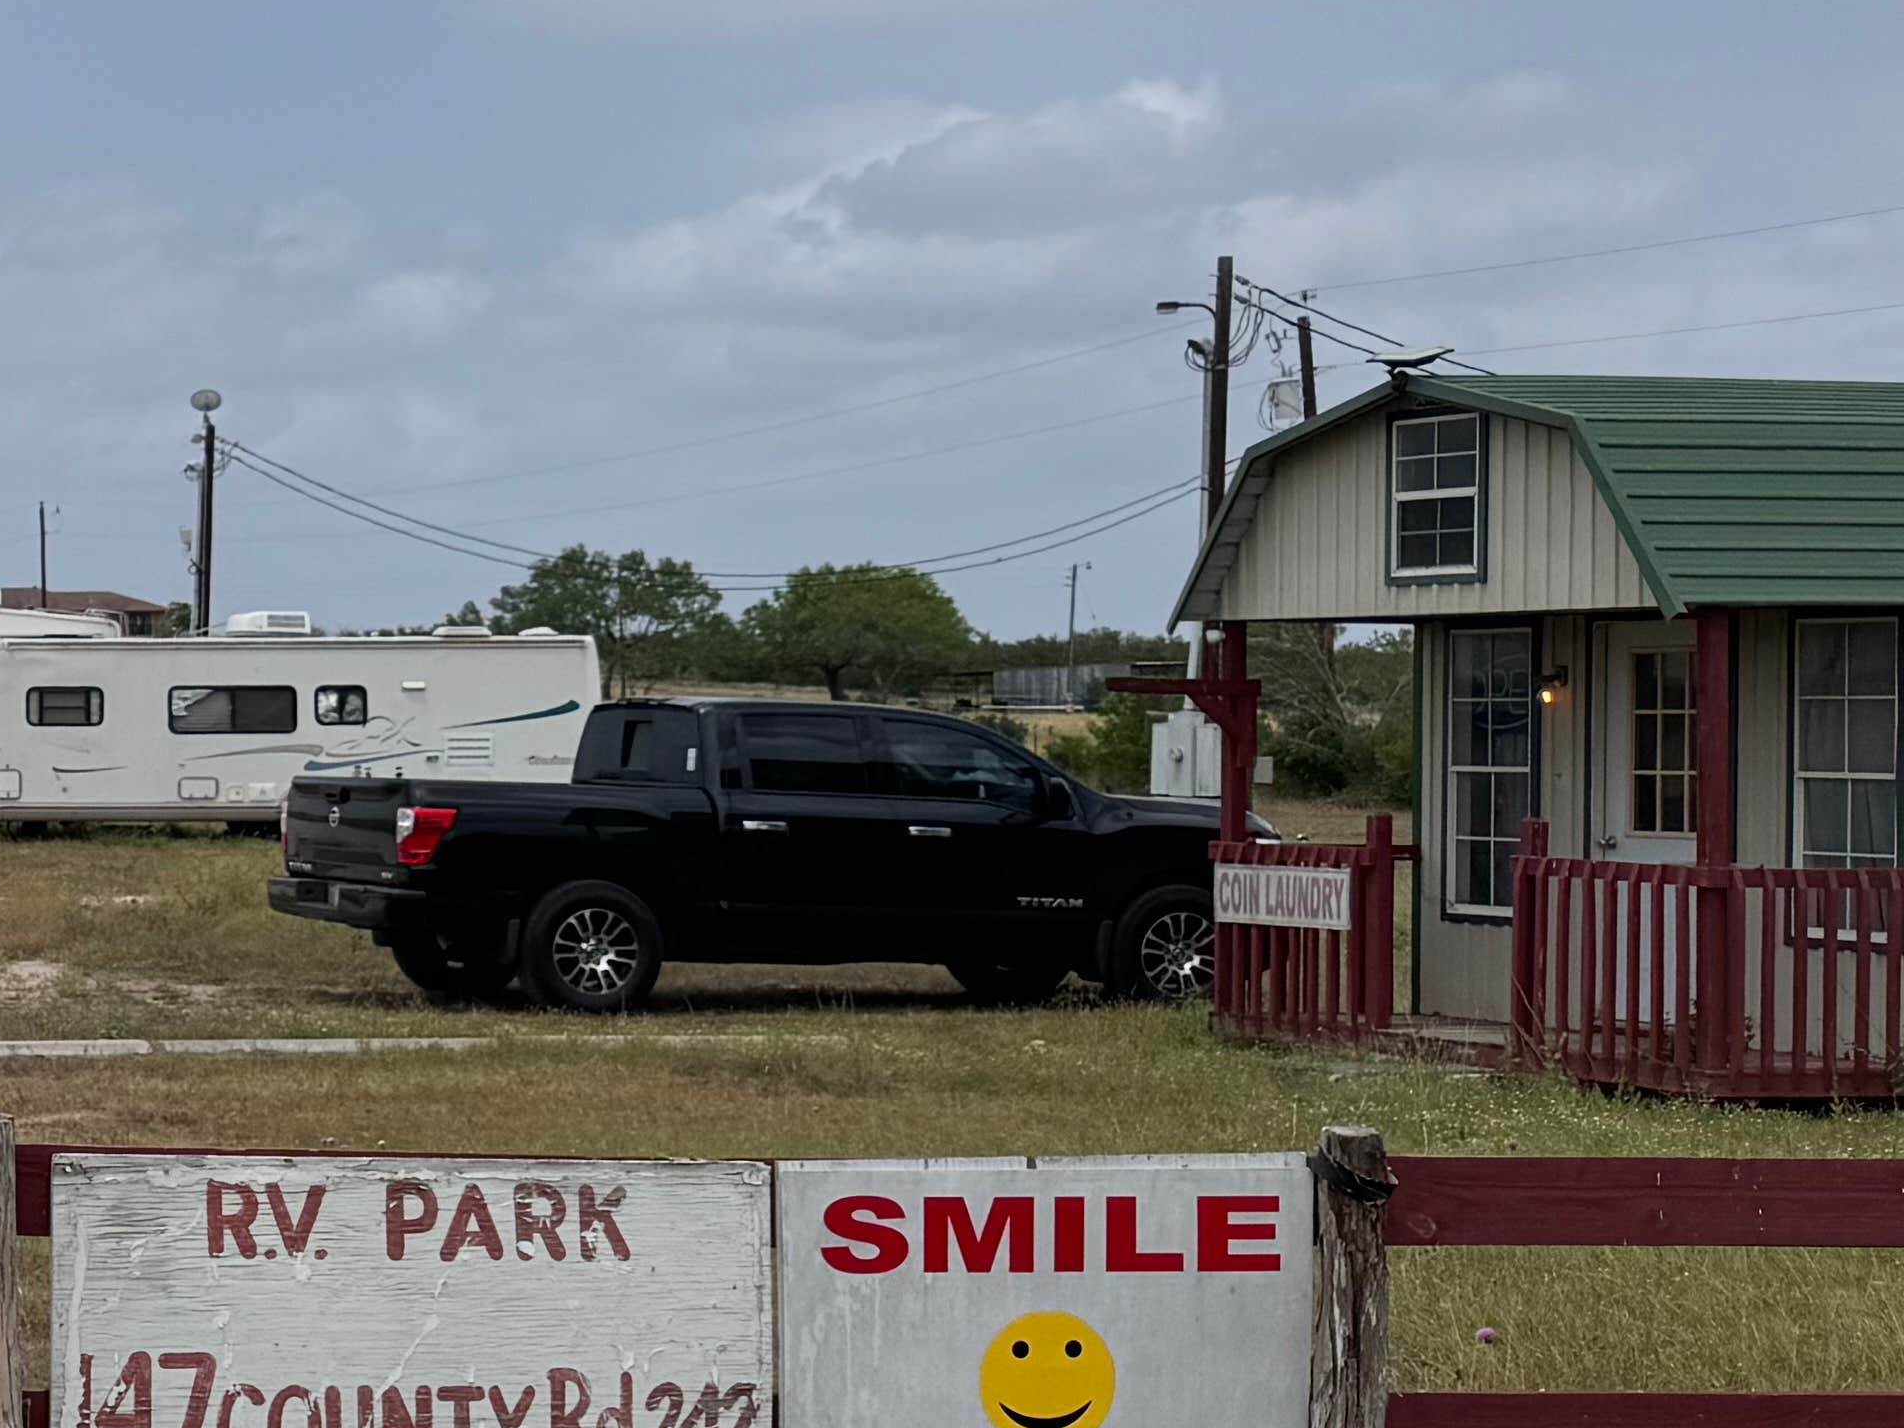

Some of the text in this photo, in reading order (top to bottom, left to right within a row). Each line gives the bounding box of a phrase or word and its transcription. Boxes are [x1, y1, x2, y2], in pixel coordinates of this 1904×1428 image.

[1016, 895, 1084, 909] TITAN
[1218, 872, 1345, 920] COIN LAUNDRY
[385, 1179, 631, 1262] PARK
[821, 1195, 1282, 1275] SMILE
